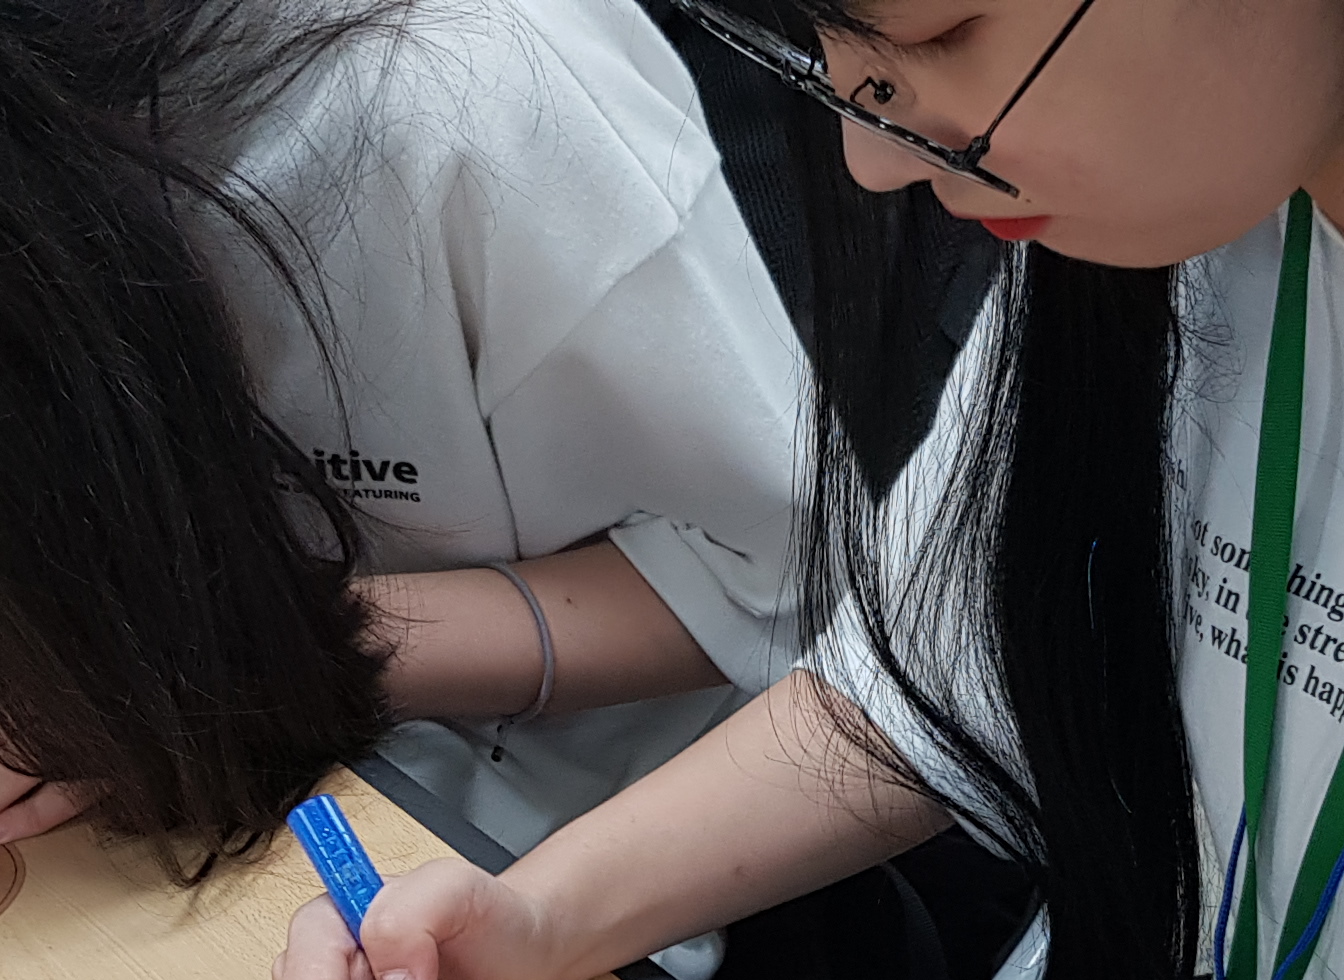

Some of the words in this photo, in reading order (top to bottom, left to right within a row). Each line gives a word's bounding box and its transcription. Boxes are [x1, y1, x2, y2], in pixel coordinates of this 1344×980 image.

[313, 447, 418, 484] itive
[343, 487, 421, 502] ATURING
[1215, 577, 1240, 614] in
